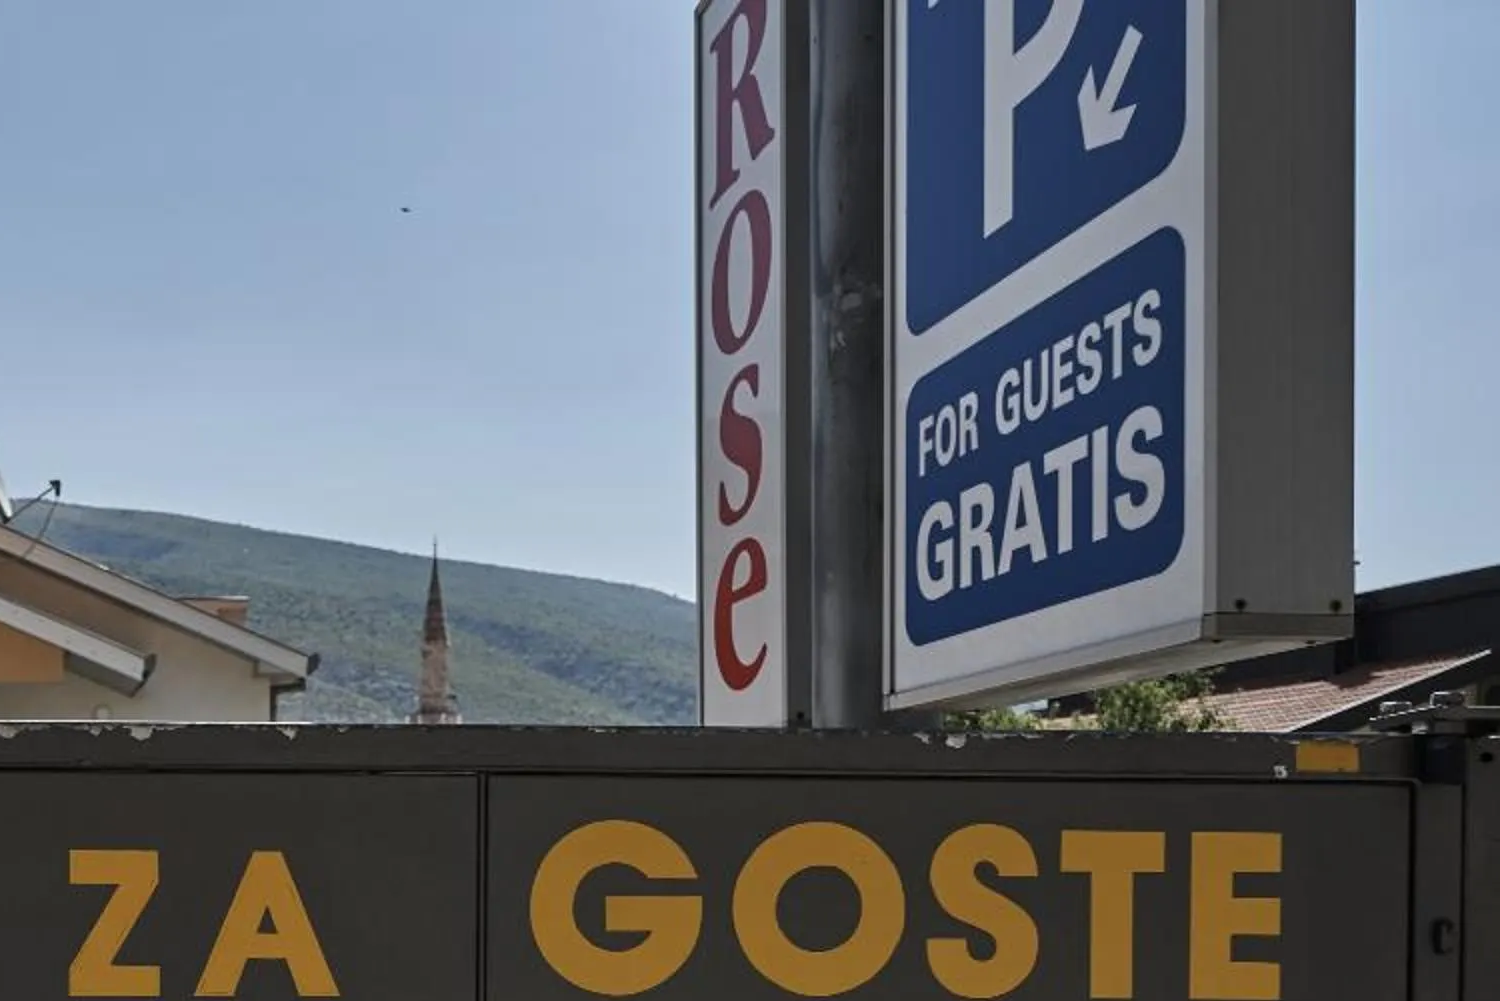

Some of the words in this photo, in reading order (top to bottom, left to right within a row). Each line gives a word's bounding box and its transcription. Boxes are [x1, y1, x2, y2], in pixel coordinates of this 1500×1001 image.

[984, 0, 1084, 239] P
[918, 391, 980, 478] FOR
[994, 288, 1164, 436] GUESTS
[915, 404, 1167, 602] GRATIS
[68, 849, 339, 998] ZA
[530, 819, 1282, 1001] GOSTE
